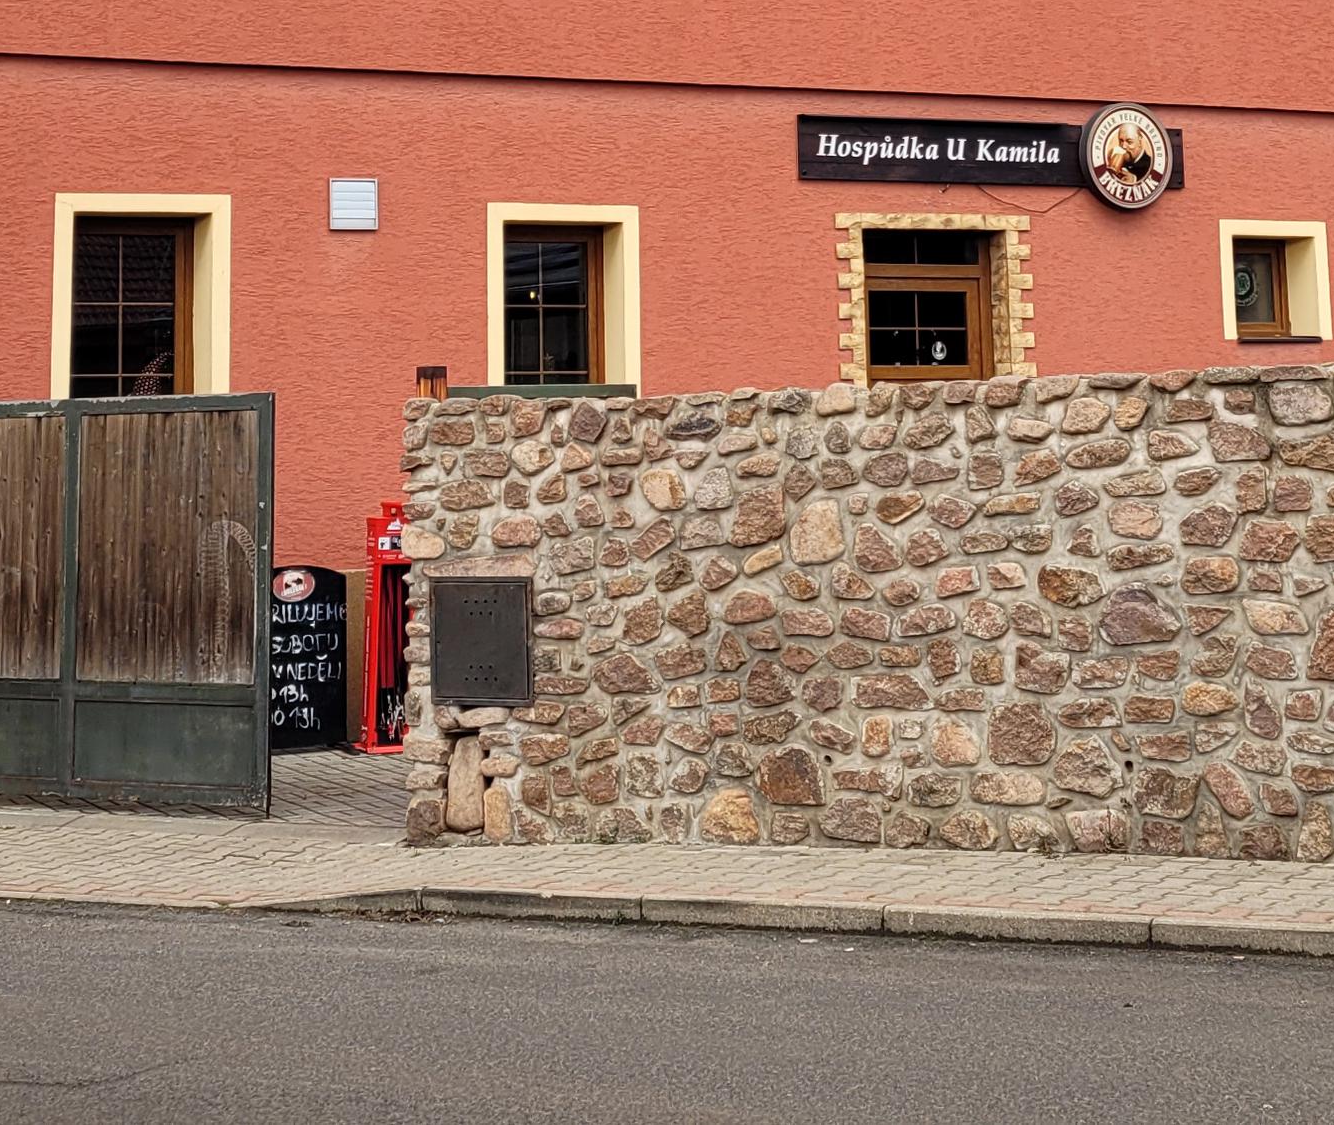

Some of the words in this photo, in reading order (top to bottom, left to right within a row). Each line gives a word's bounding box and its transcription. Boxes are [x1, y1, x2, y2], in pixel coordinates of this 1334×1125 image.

[816, 134, 940, 165] Hospůdka
[946, 138, 967, 161] U
[975, 139, 1061, 163] Kamila
[271, 603, 348, 624] RILUJEME
[287, 654, 341, 682] NEDĚLI
[279, 684, 309, 703] 13h
